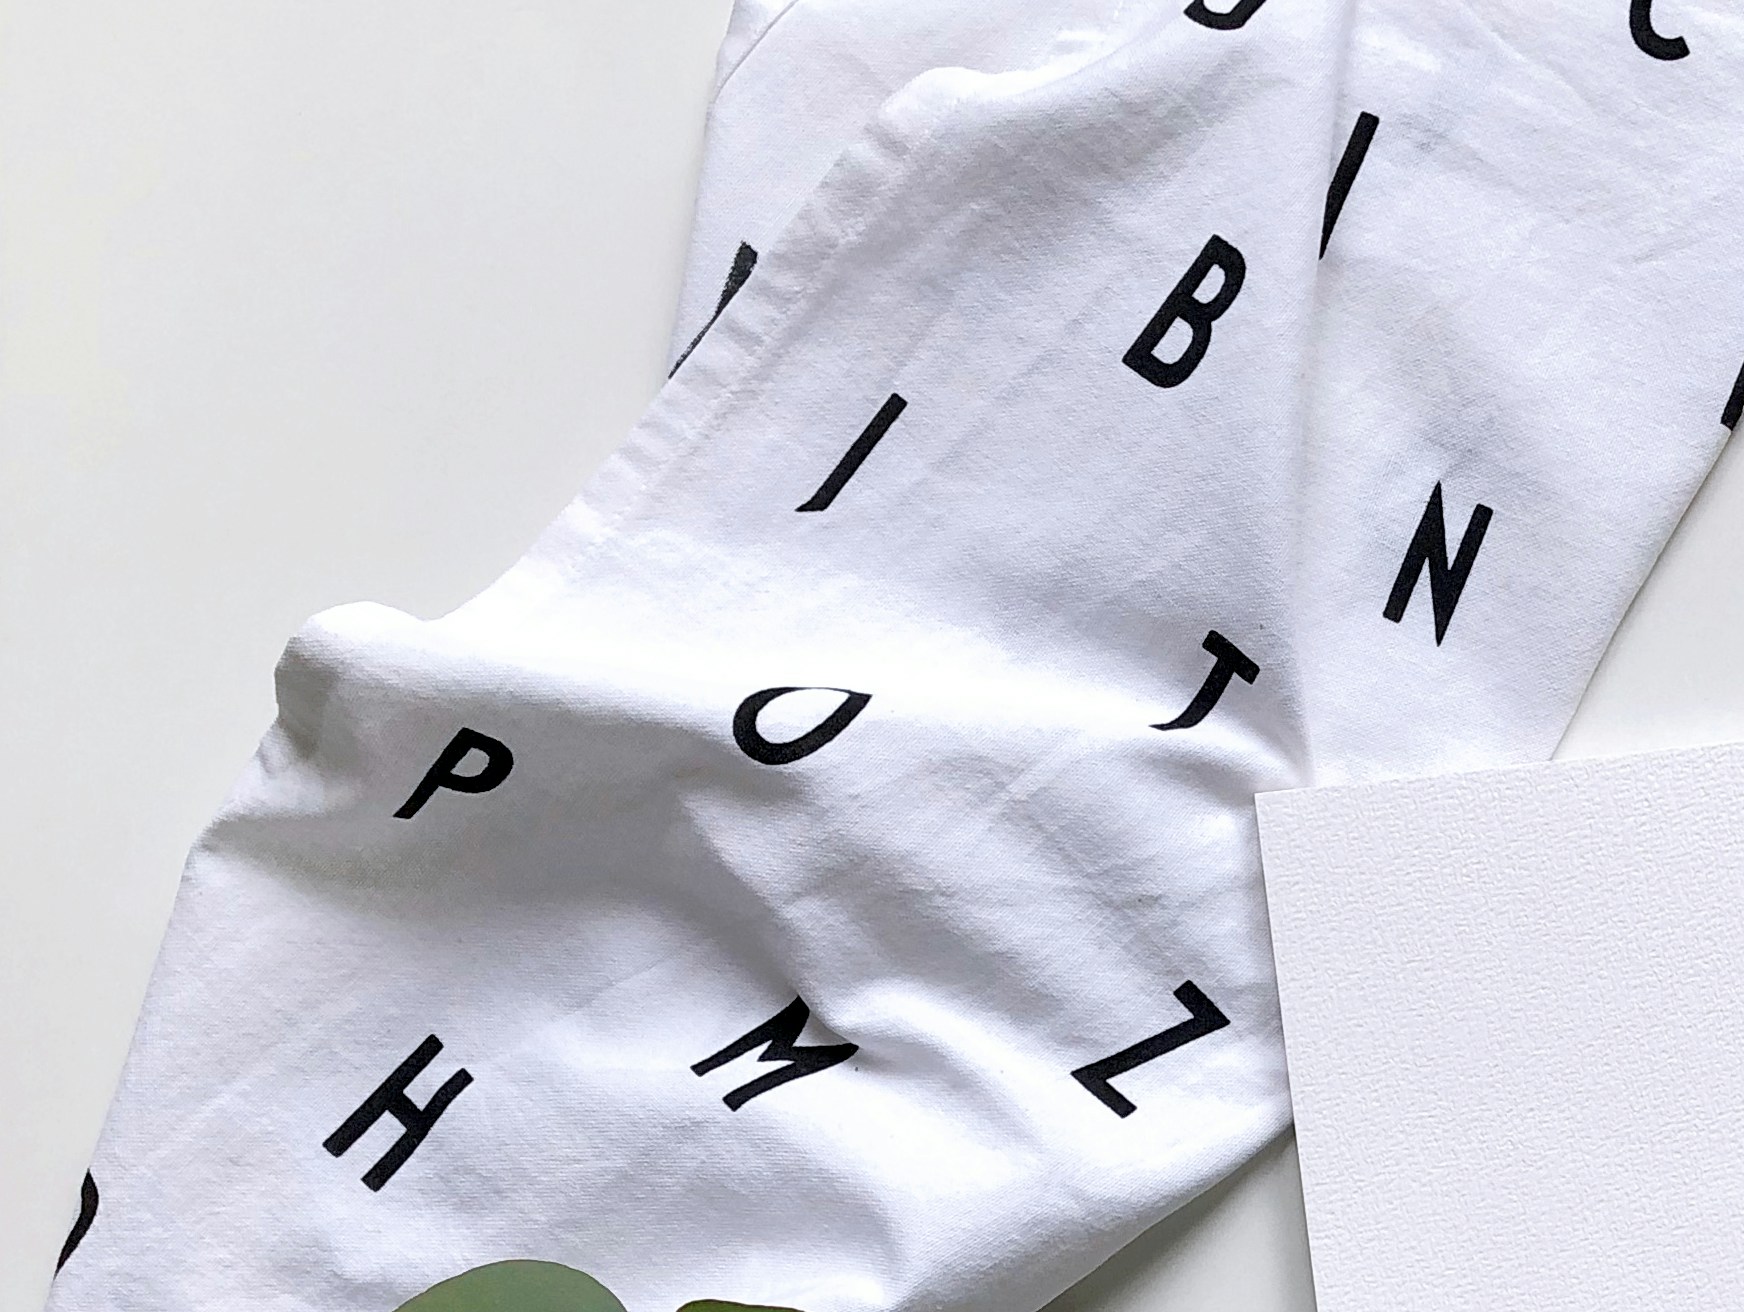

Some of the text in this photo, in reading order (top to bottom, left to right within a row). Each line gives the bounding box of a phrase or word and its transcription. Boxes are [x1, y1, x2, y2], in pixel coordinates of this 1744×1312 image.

[1121, 234, 1247, 389] B
[1382, 480, 1494, 648] N
[732, 686, 873, 766] O
[1149, 629, 1261, 732] T
[392, 726, 515, 820] P
[322, 1033, 474, 1193] H
[690, 993, 860, 1113] M
[1070, 979, 1231, 1120] Z
